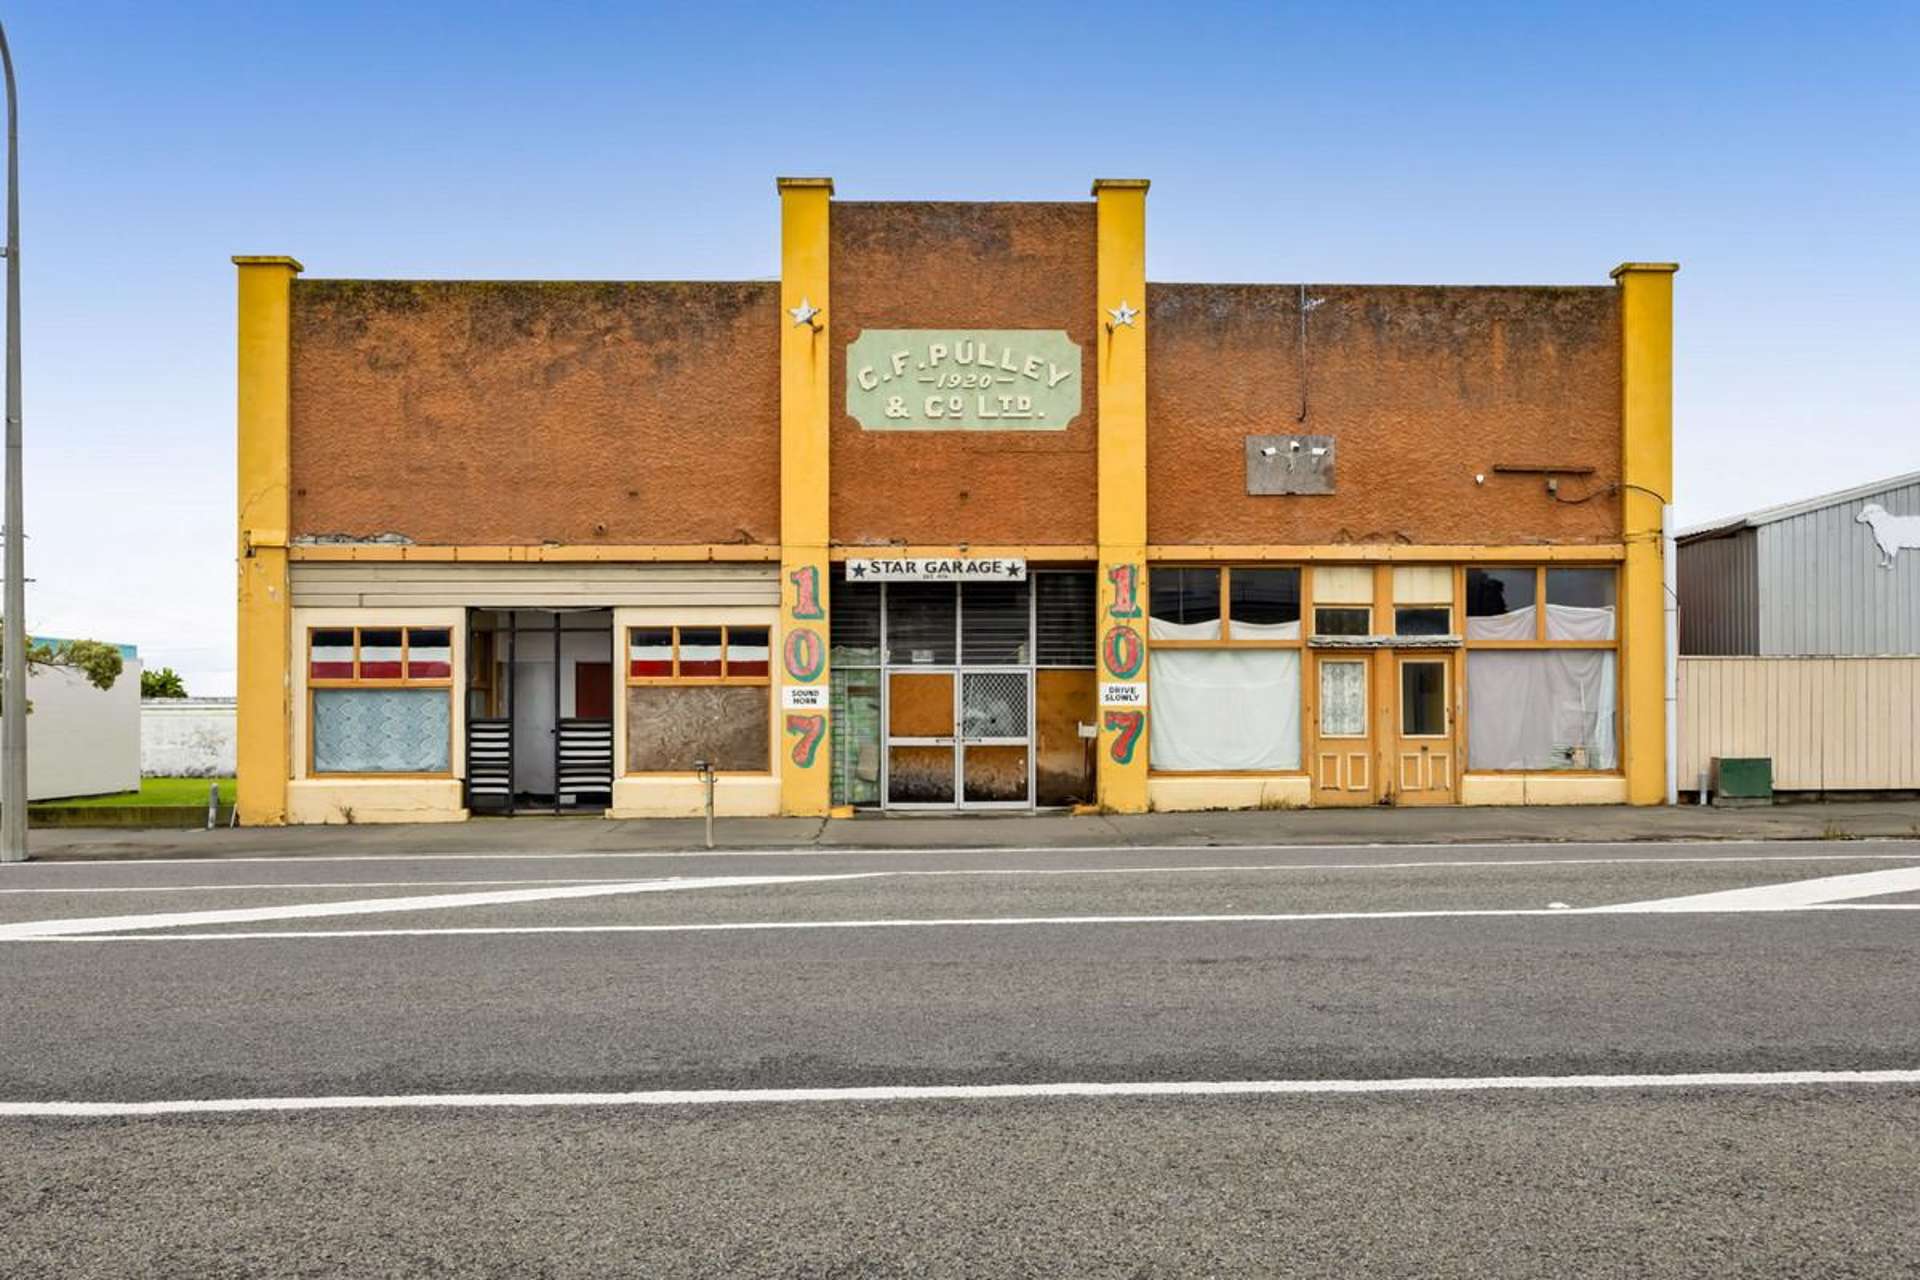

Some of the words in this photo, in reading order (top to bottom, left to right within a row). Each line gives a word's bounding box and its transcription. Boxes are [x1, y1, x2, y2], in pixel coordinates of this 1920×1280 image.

[885, 396, 910, 418] &
[870, 561, 917, 574] STAR
[924, 561, 1002, 574] GARAGE
